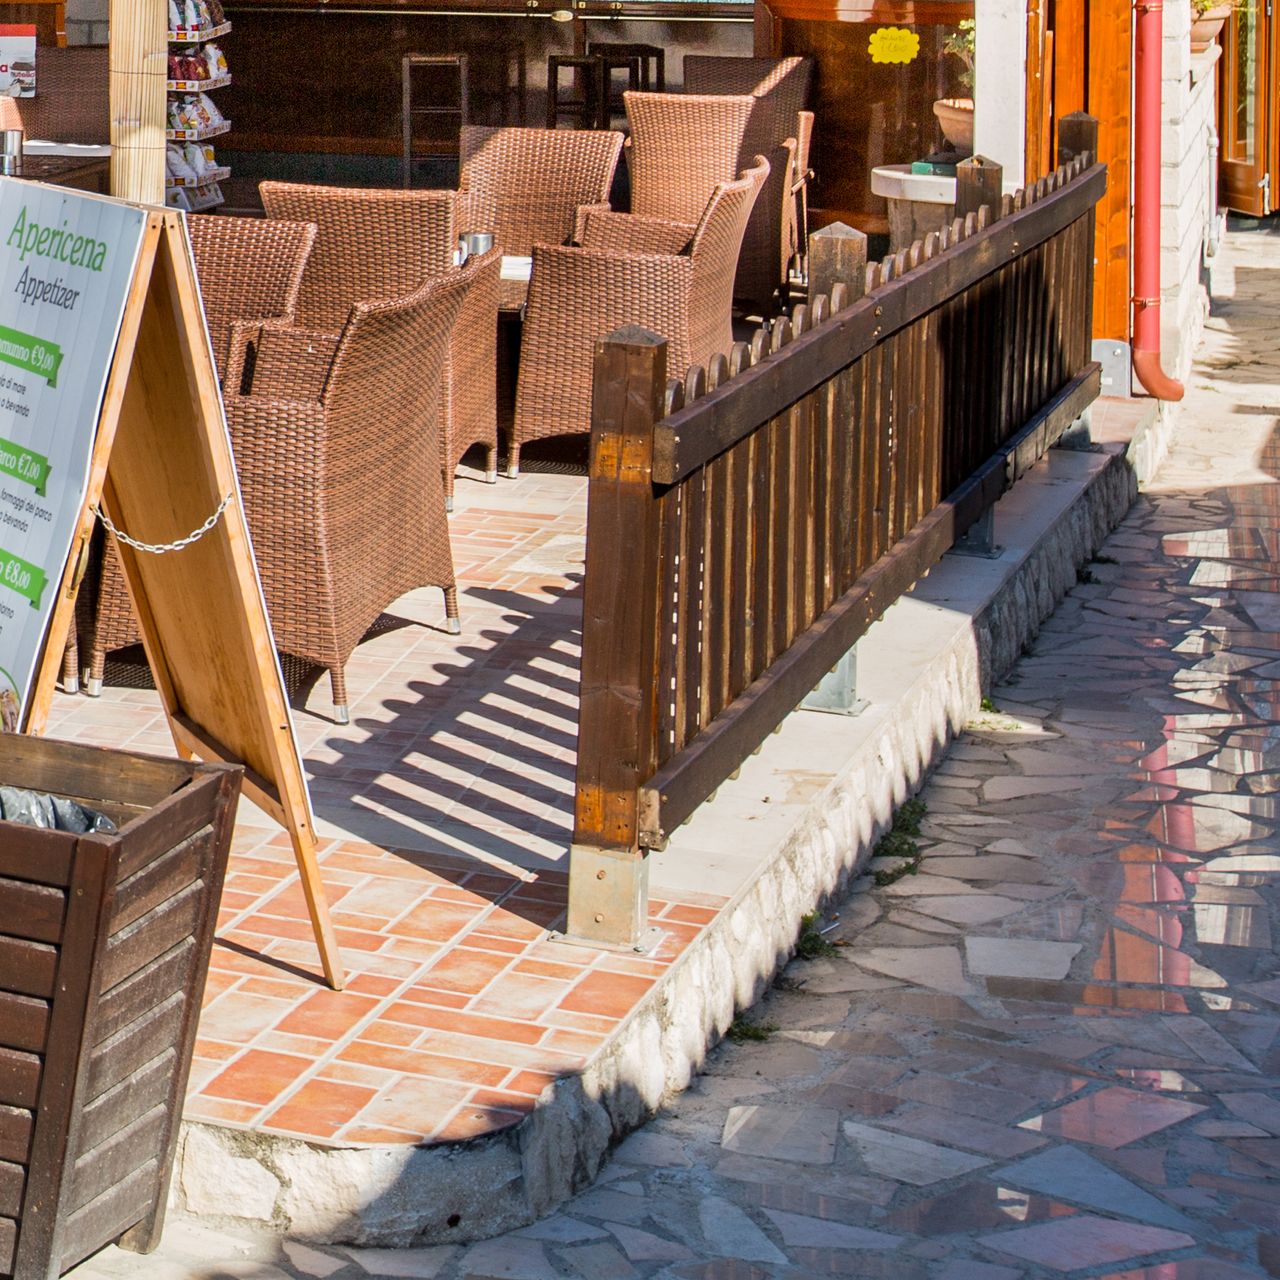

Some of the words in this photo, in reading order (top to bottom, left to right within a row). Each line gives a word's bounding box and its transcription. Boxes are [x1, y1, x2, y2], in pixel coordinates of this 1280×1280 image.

[6, 205, 108, 272] Apericena
[14, 265, 80, 310] Appetizer
[31, 345, 55, 371] €9,00
[13, 382, 27, 396] mare
[5, 397, 30, 418] bevanda
[17, 453, 40, 480] €7,00
[1, 487, 25, 511] formaggi
[33, 506, 53, 522] parco
[3, 512, 28, 533] bevanda
[5, 560, 31, 589] €8,00
